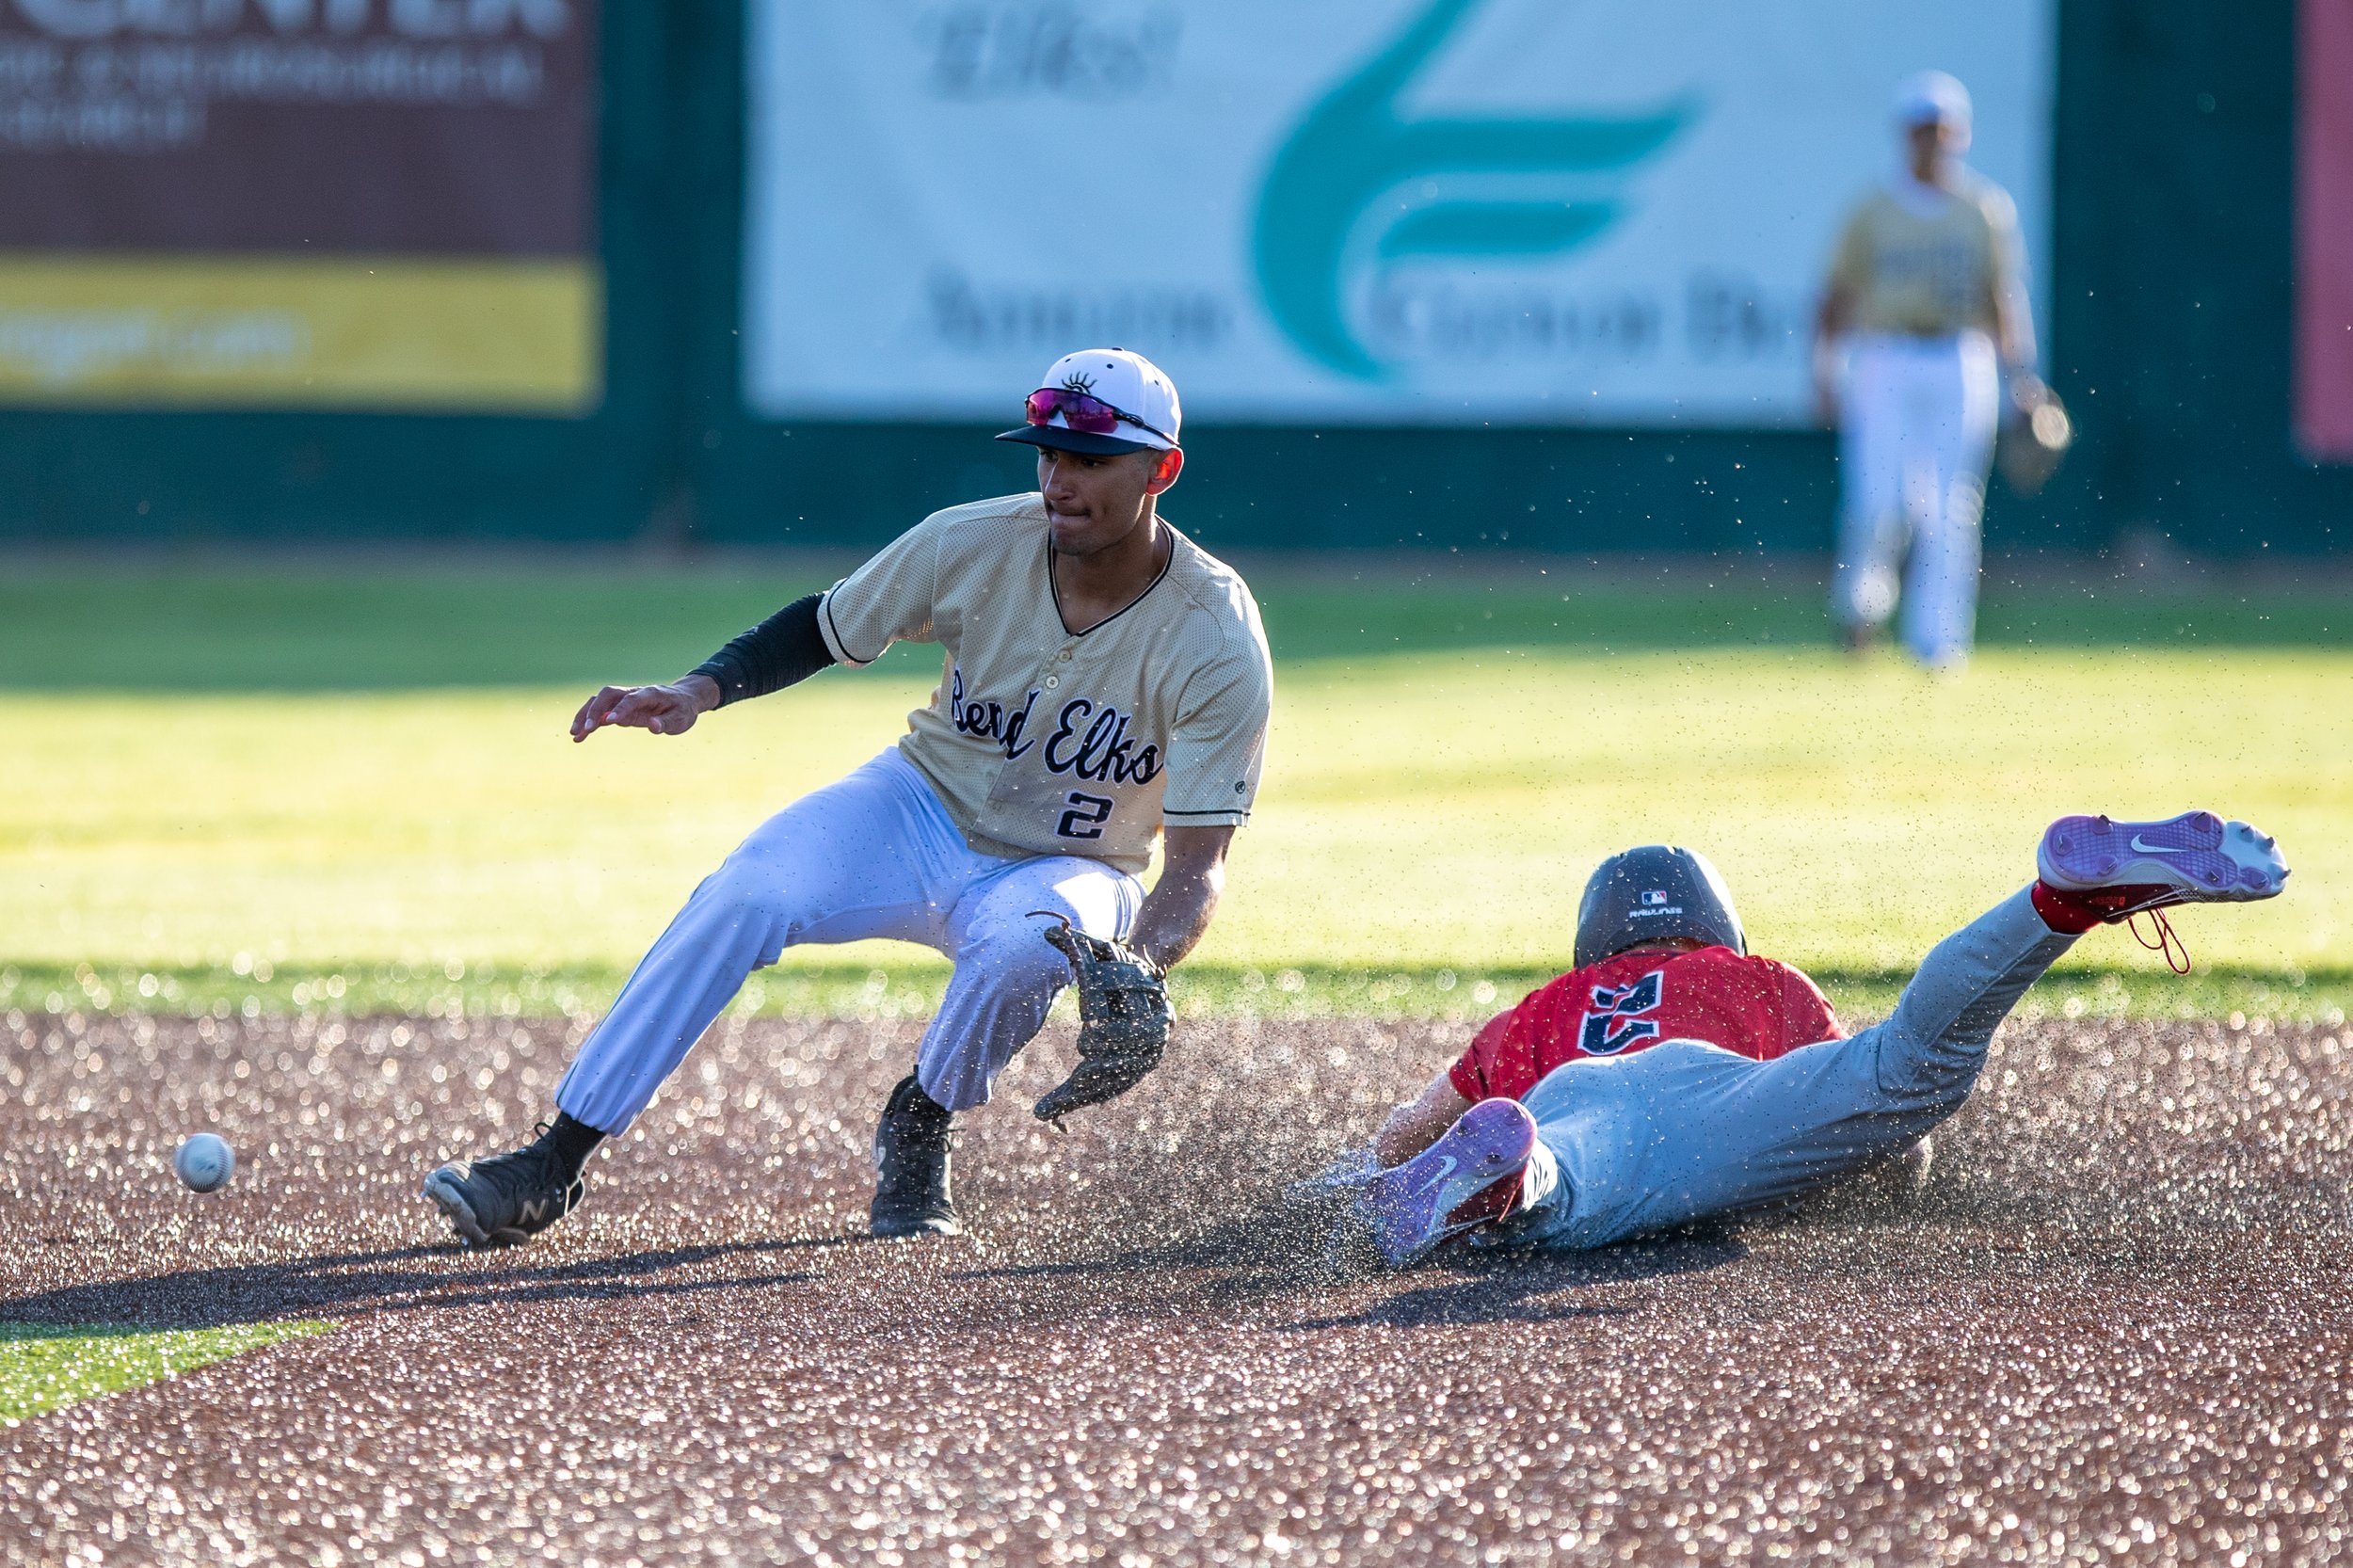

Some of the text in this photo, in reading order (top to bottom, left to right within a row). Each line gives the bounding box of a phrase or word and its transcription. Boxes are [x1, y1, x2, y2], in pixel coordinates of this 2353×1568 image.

[951, 668, 1165, 786] Bend Elks
[1054, 789, 1114, 840] 2
